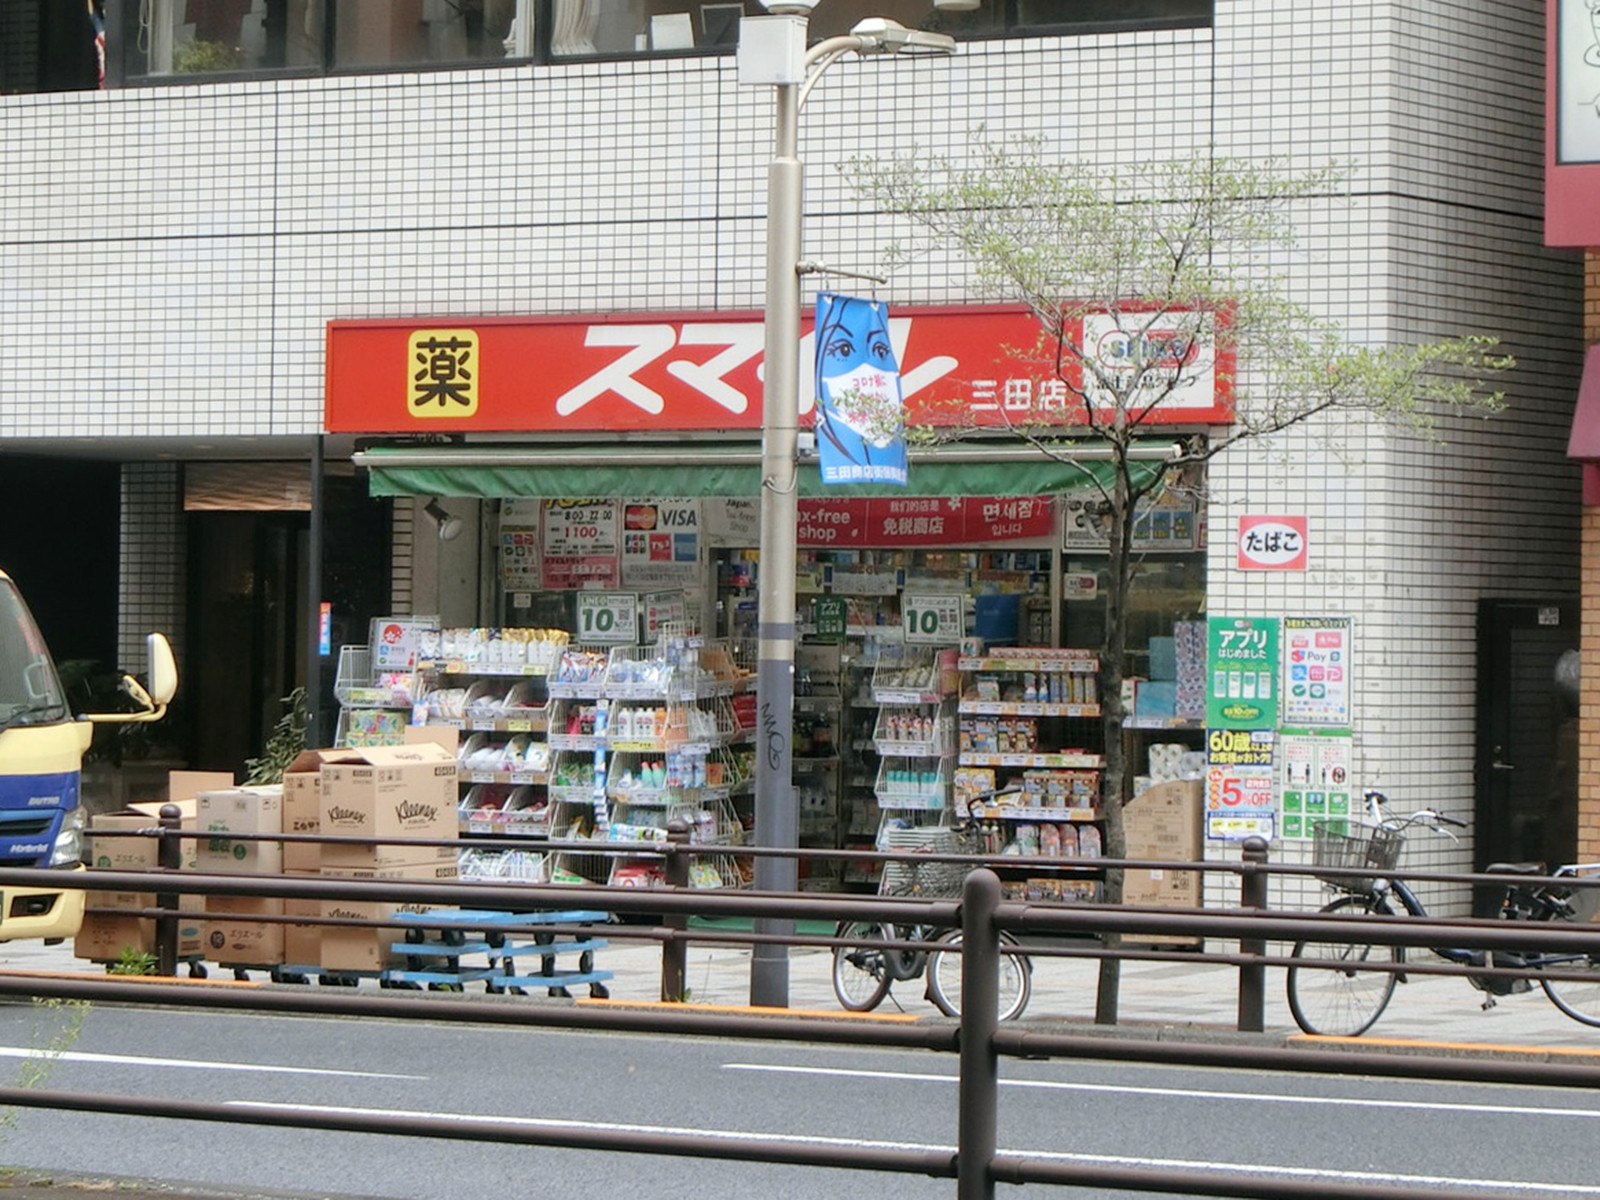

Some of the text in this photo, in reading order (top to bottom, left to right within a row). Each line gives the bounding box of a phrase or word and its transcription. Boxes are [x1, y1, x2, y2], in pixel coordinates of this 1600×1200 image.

[414, 336, 472, 406] 薬
[556, 317, 959, 416] スマル
[970, 379, 1067, 411] 三田店
[890, 500, 940, 513] 我们的店是
[982, 500, 1034, 522] 면세점
[662, 509, 697, 526] VISA
[883, 516, 944, 535] 免税商店
[798, 524, 837, 541] shop
[991, 523, 1022, 536] 입니다
[1246, 531, 1299, 552] たばこ
[1218, 629, 1268, 648] アプリ
[1218, 649, 1267, 659] はじめました
[1307, 652, 1326, 662] Pay
[328, 805, 367, 824] Kleenex
[395, 800, 439, 824] Kleenex
[10, 844, 49, 854] Hybrid
